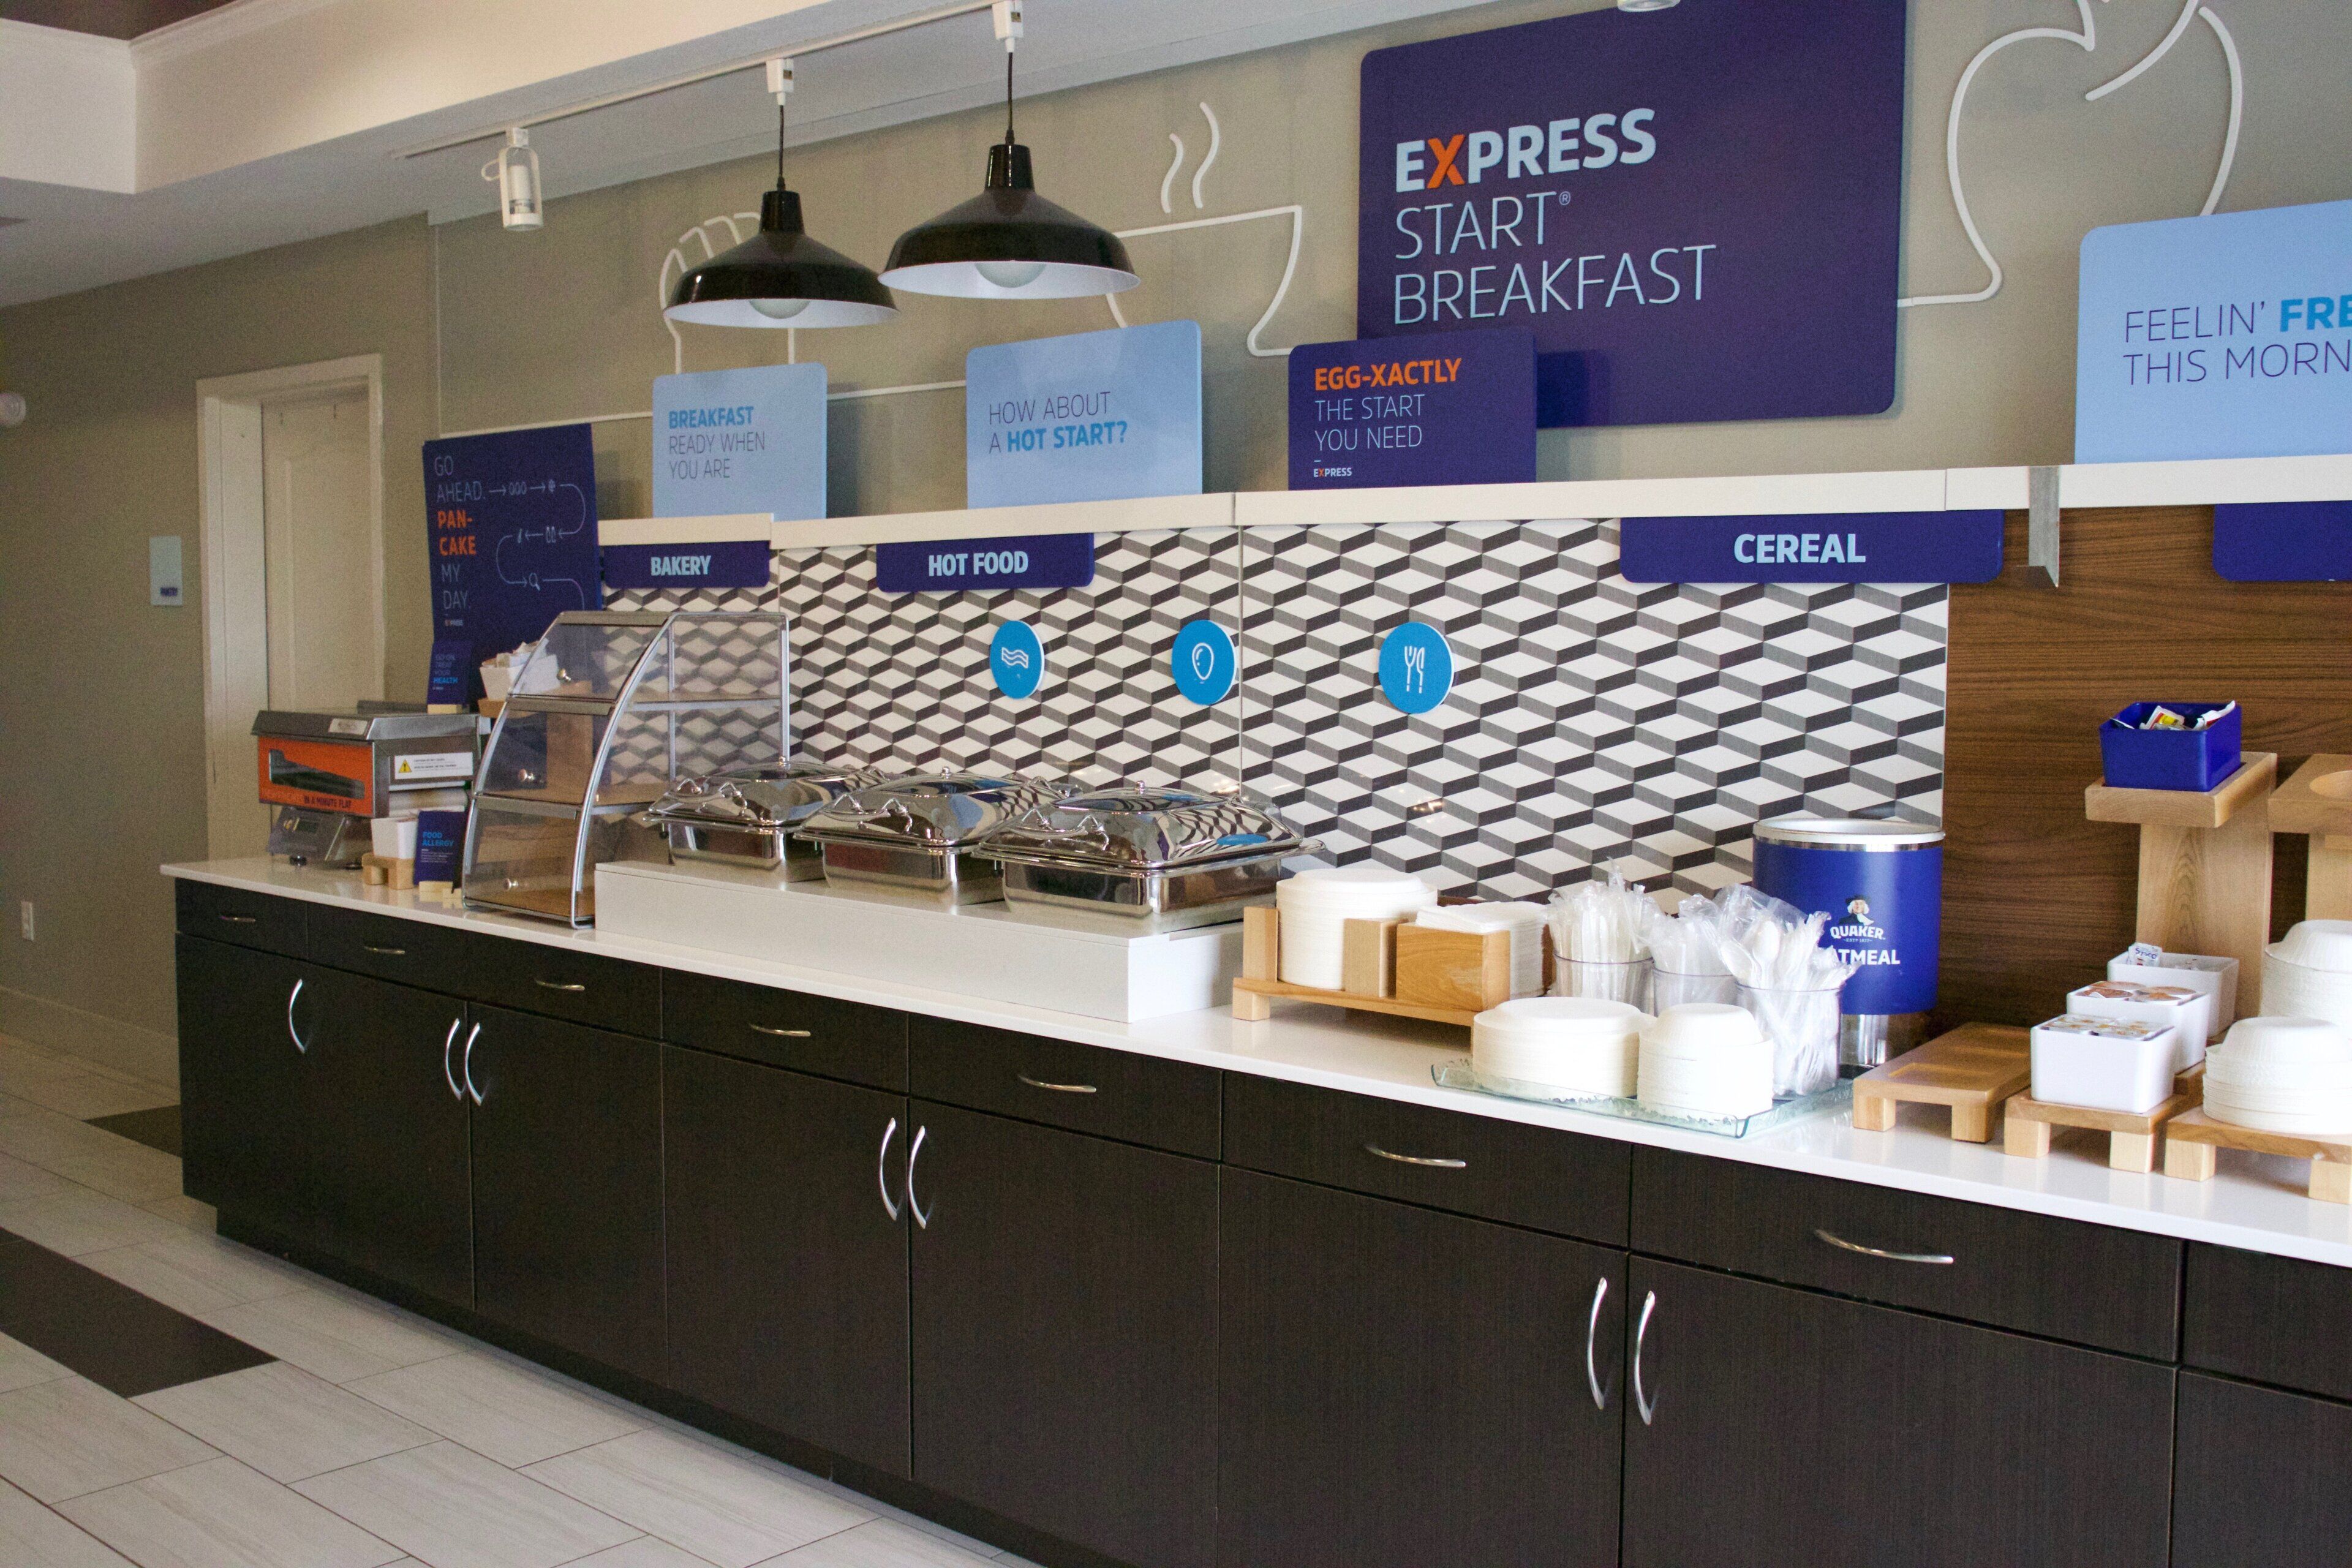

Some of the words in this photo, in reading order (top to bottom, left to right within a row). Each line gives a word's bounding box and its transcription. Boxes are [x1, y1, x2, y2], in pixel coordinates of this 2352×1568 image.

[1395, 108, 1657, 193] EXPRESS
[1394, 244, 1717, 325] BREAKFAST
[2123, 349, 2207, 385] THIS
[2225, 339, 2352, 380] MORN
[1314, 358, 1462, 391] EGG-XACTLY
[668, 406, 755, 430] BREAKFAST
[989, 399, 1036, 425] HOW
[1042, 391, 1111, 420] ABOUT
[1314, 398, 1354, 421] THE
[1362, 394, 1425, 420] START
[669, 434, 715, 455] READY
[720, 431, 766, 453] WHEN
[988, 432, 1001, 454] A
[1006, 428, 1047, 453] HOT
[1053, 420, 1128, 449] START?
[1314, 428, 1358, 451] YOU
[1366, 424, 1422, 449] NEED
[434, 455, 453, 477] GO
[668, 459, 698, 480] YOU
[703, 458, 731, 478] ARE
[1313, 467, 1352, 478] EXPRESS
[436, 480, 486, 503] AHEAD.
[437, 510, 473, 529] PAN-
[439, 535, 477, 557] CAKE
[1733, 533, 1867, 564] CEREAL
[441, 564, 461, 583] MY
[650, 555, 712, 576] BAKERY
[929, 553, 968, 577] HOT
[973, 551, 1029, 575] FOOD
[1830, 925, 1884, 940] QUAKER
